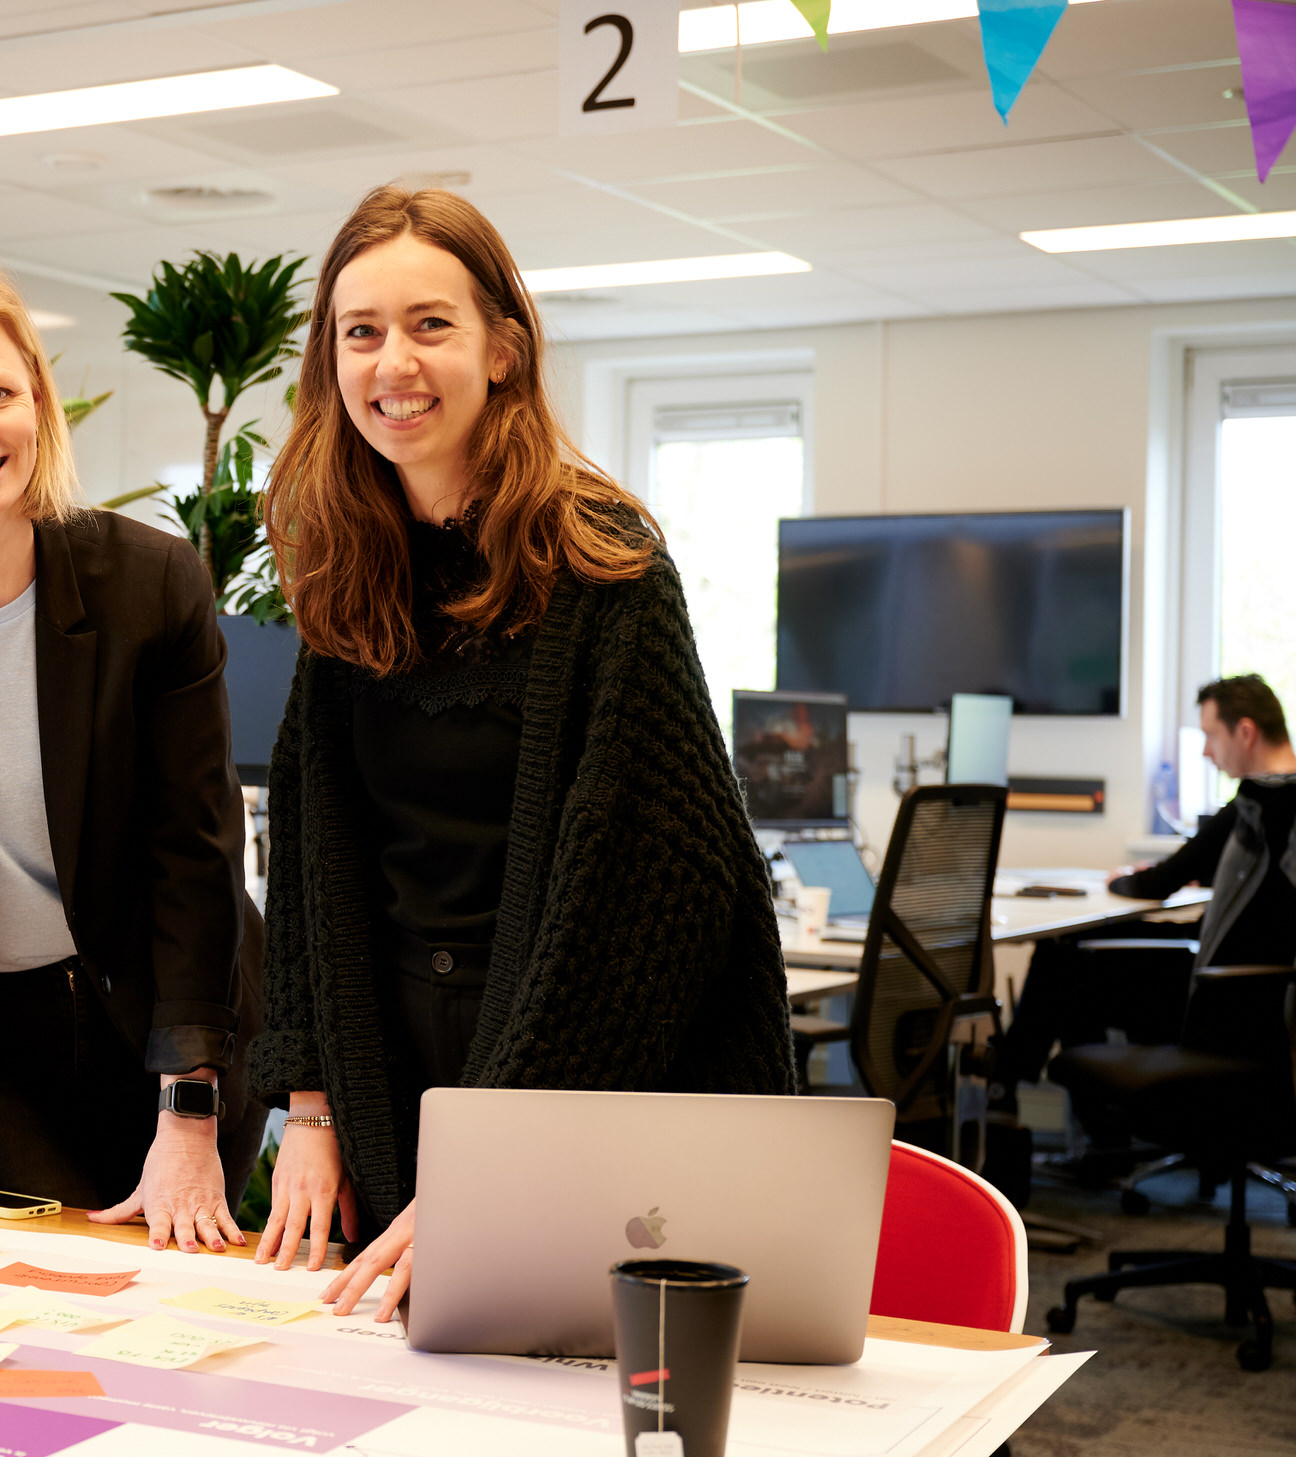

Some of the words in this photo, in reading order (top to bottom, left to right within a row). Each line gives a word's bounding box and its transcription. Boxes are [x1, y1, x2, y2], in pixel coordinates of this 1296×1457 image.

[583, 14, 635, 111] 2
[733, 1383, 891, 1410] Potentie
[198, 1420, 318, 1448] Volger
